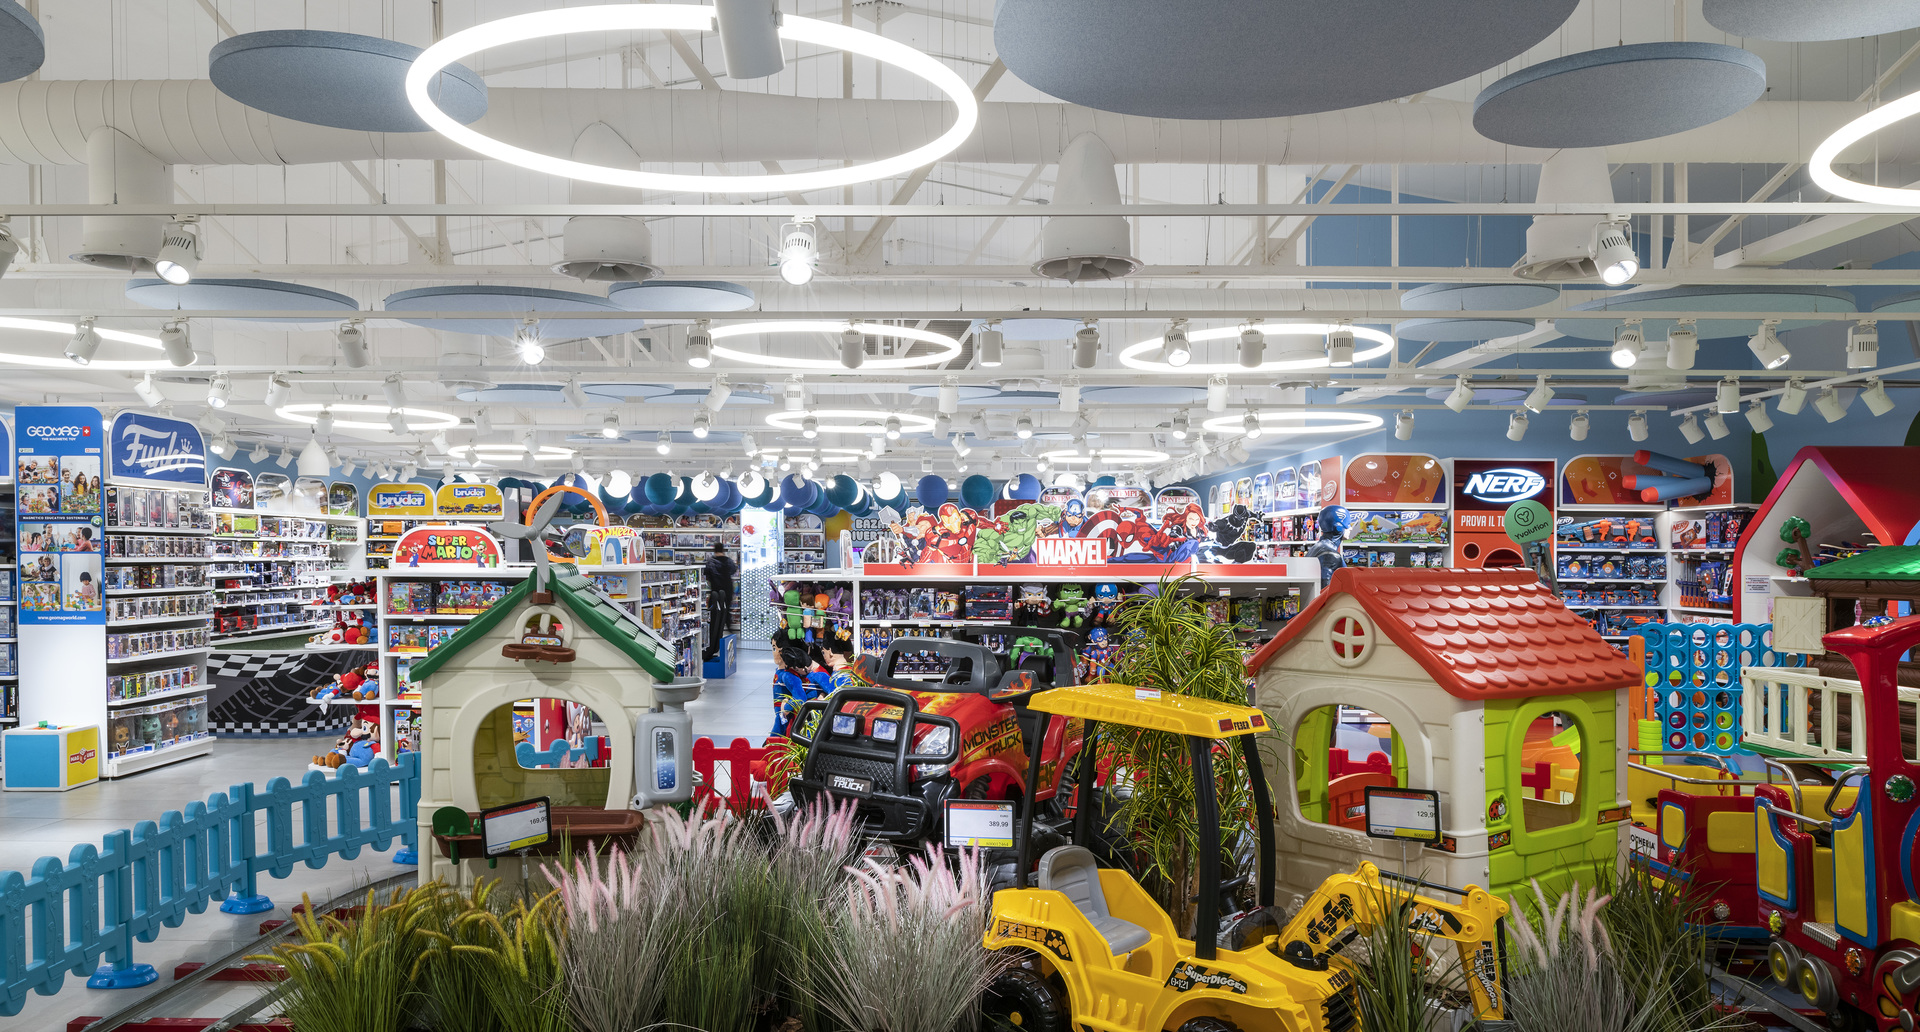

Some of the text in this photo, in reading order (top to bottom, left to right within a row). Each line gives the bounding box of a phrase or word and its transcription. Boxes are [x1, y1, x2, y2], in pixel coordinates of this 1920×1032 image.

[26, 426, 80, 436] GEOMAG
[122, 424, 188, 472] Funko
[1463, 472, 1545, 495] NERF
[378, 494, 424, 506] bruder
[454, 488, 484, 497] bruder
[856, 518, 889, 530] BAZA
[1461, 515, 1486, 527] PROVA
[1489, 516, 1495, 527] IL
[1514, 522, 1549, 540] Yvolution
[428, 535, 467, 550] SUPER
[421, 550, 474, 565] MARIO
[1038, 540, 1105, 564] MARVEL
[963, 718, 1019, 752] MONSTER
[986, 732, 1021, 757] TRUCK
[834, 779, 864, 791] TRUCK
[1307, 894, 1354, 944] FEBER
[999, 920, 1047, 942] FEBER
